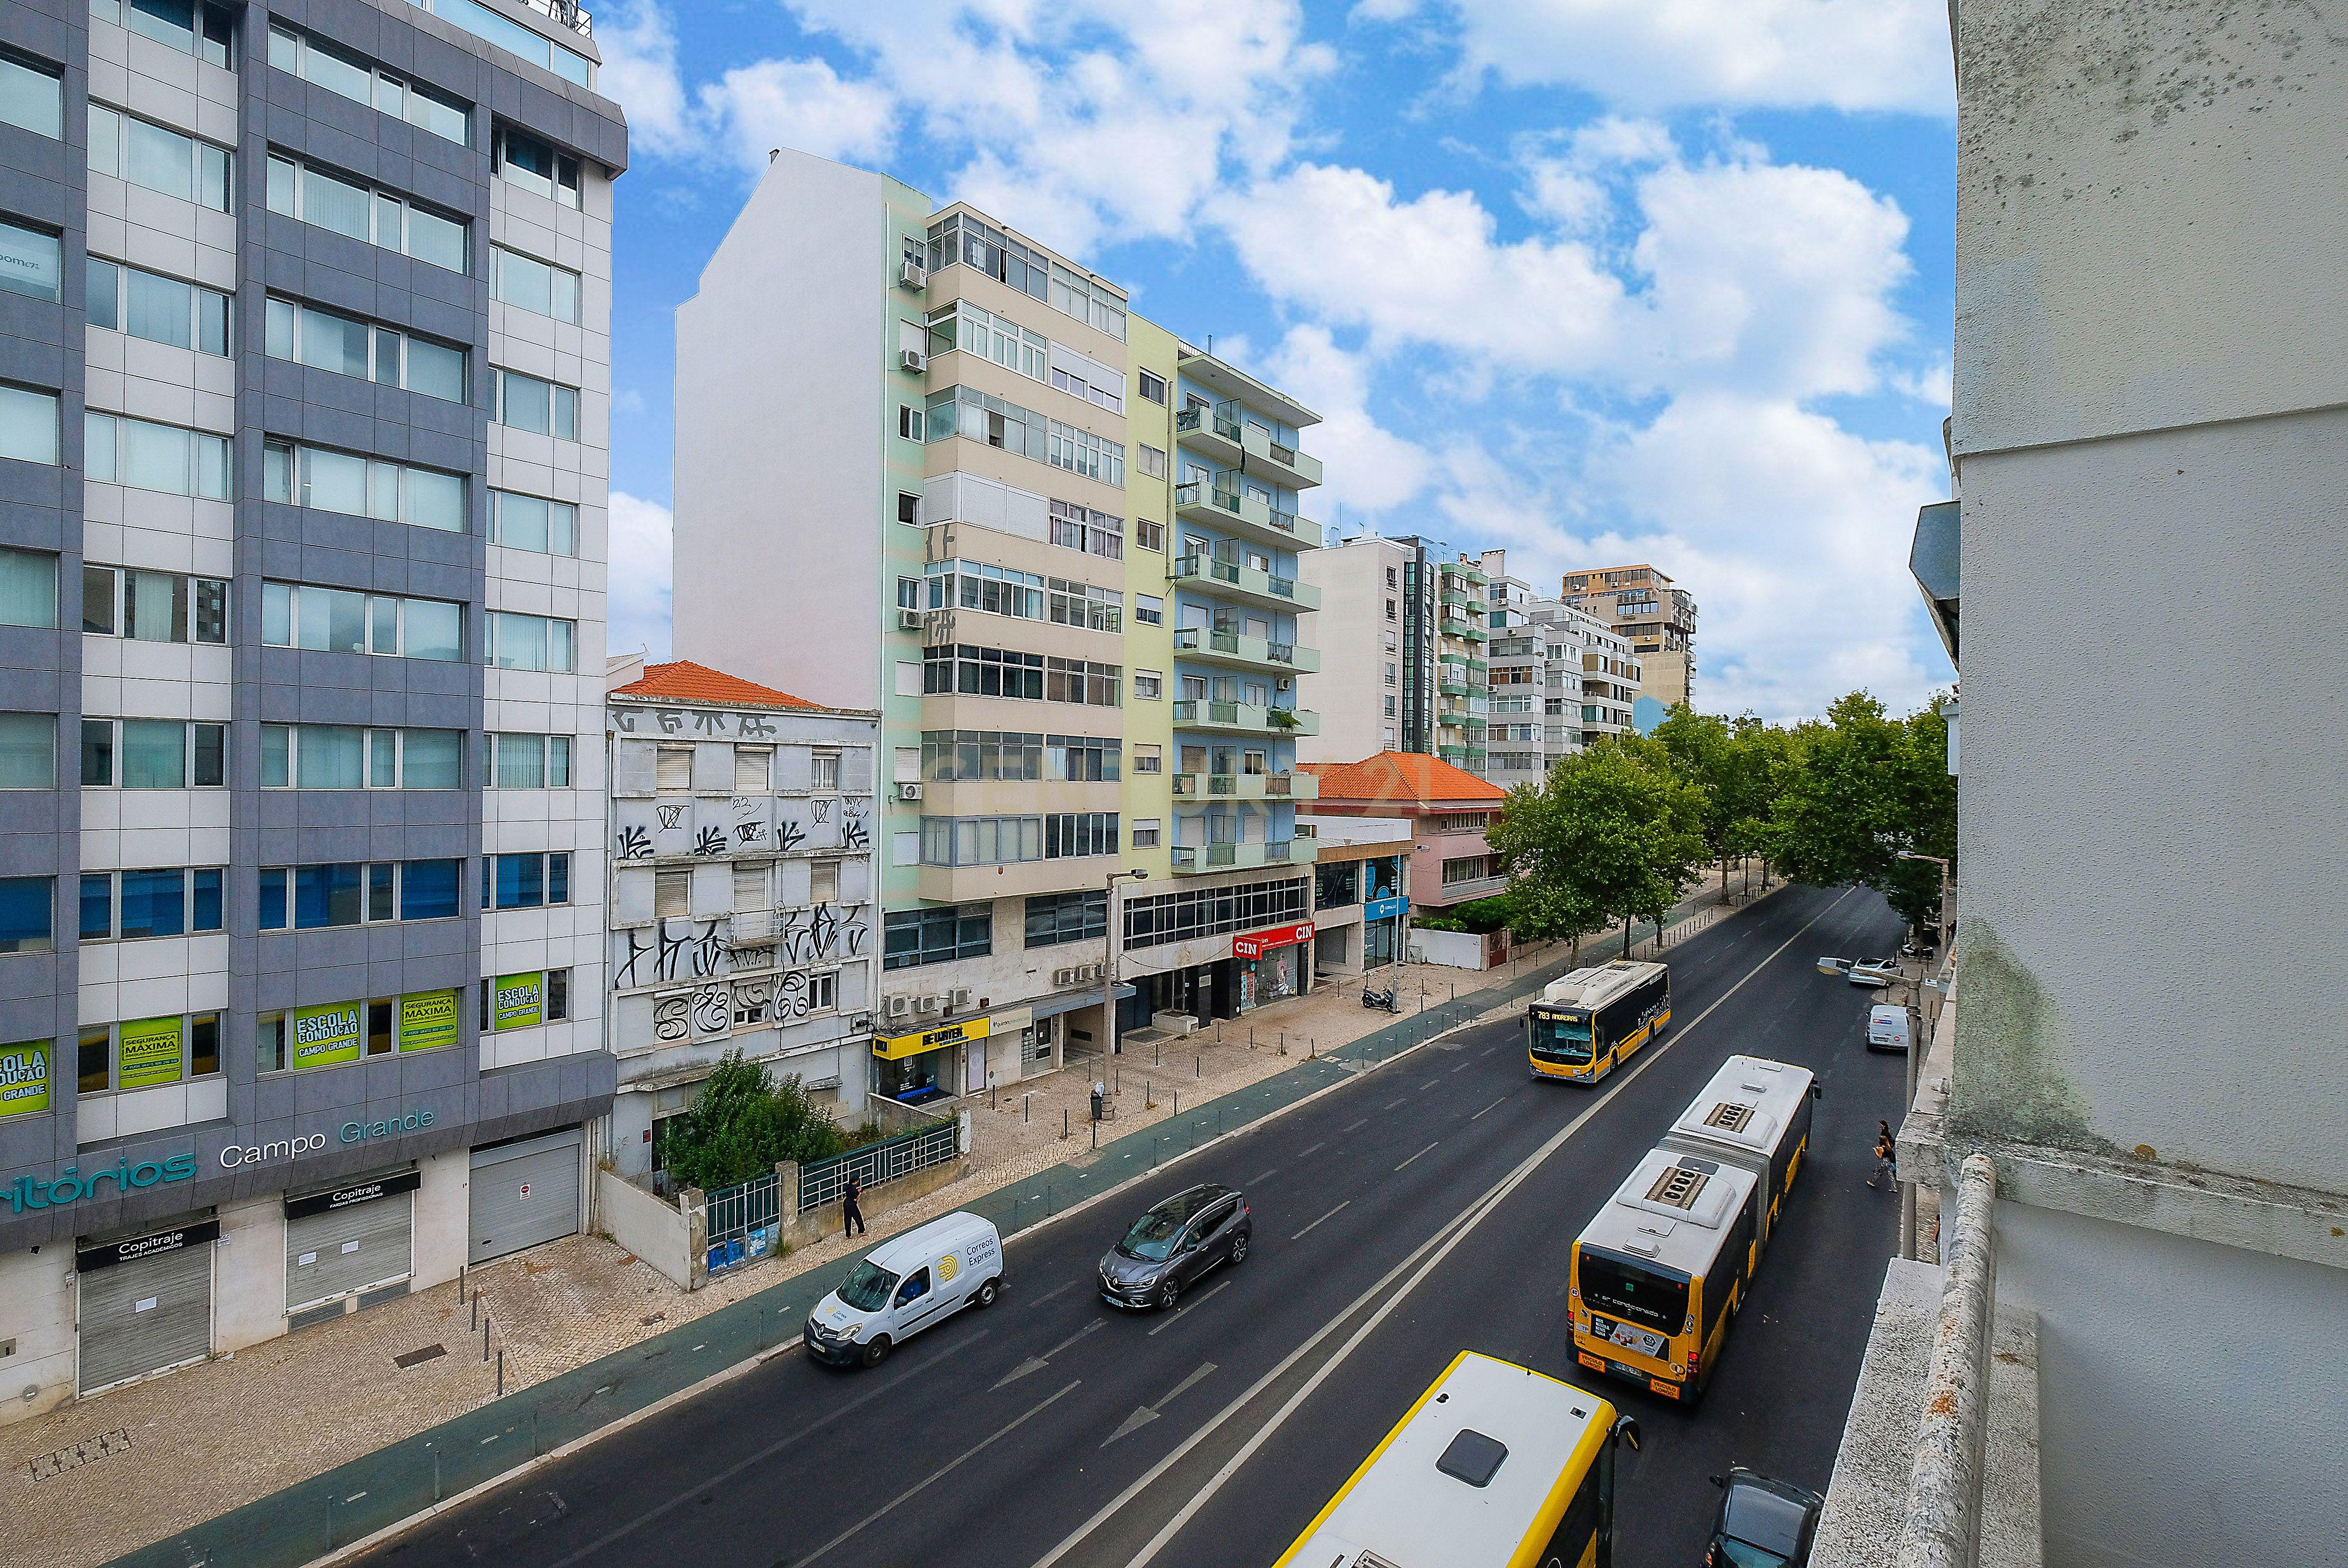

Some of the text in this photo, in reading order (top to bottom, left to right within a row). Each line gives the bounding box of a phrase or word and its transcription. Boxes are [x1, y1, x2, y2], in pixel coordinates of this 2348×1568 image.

[1296, 925, 1312, 940] CIN
[1235, 942, 1257, 955] CIN
[497, 984, 539, 1002] ESCOLA
[499, 1006, 539, 1019] CAMPO GRANDE
[1538, 1011, 1549, 1020] 783
[296, 1010, 358, 1034] ESCOLA
[299, 1038, 358, 1058] CAMPO GRANDE
[0, 1051, 46, 1073] OLA
[3, 1084, 45, 1101] GRANDE
[220, 1133, 326, 1168] Campo
[339, 1109, 434, 1143] Grande
[333, 1184, 381, 1201] Copitraje
[119, 1232, 183, 1254] Copitraje
[966, 1238, 993, 1256] Correos
[119, 1252, 142, 1261] TRAJES
[969, 1247, 995, 1266] Express
